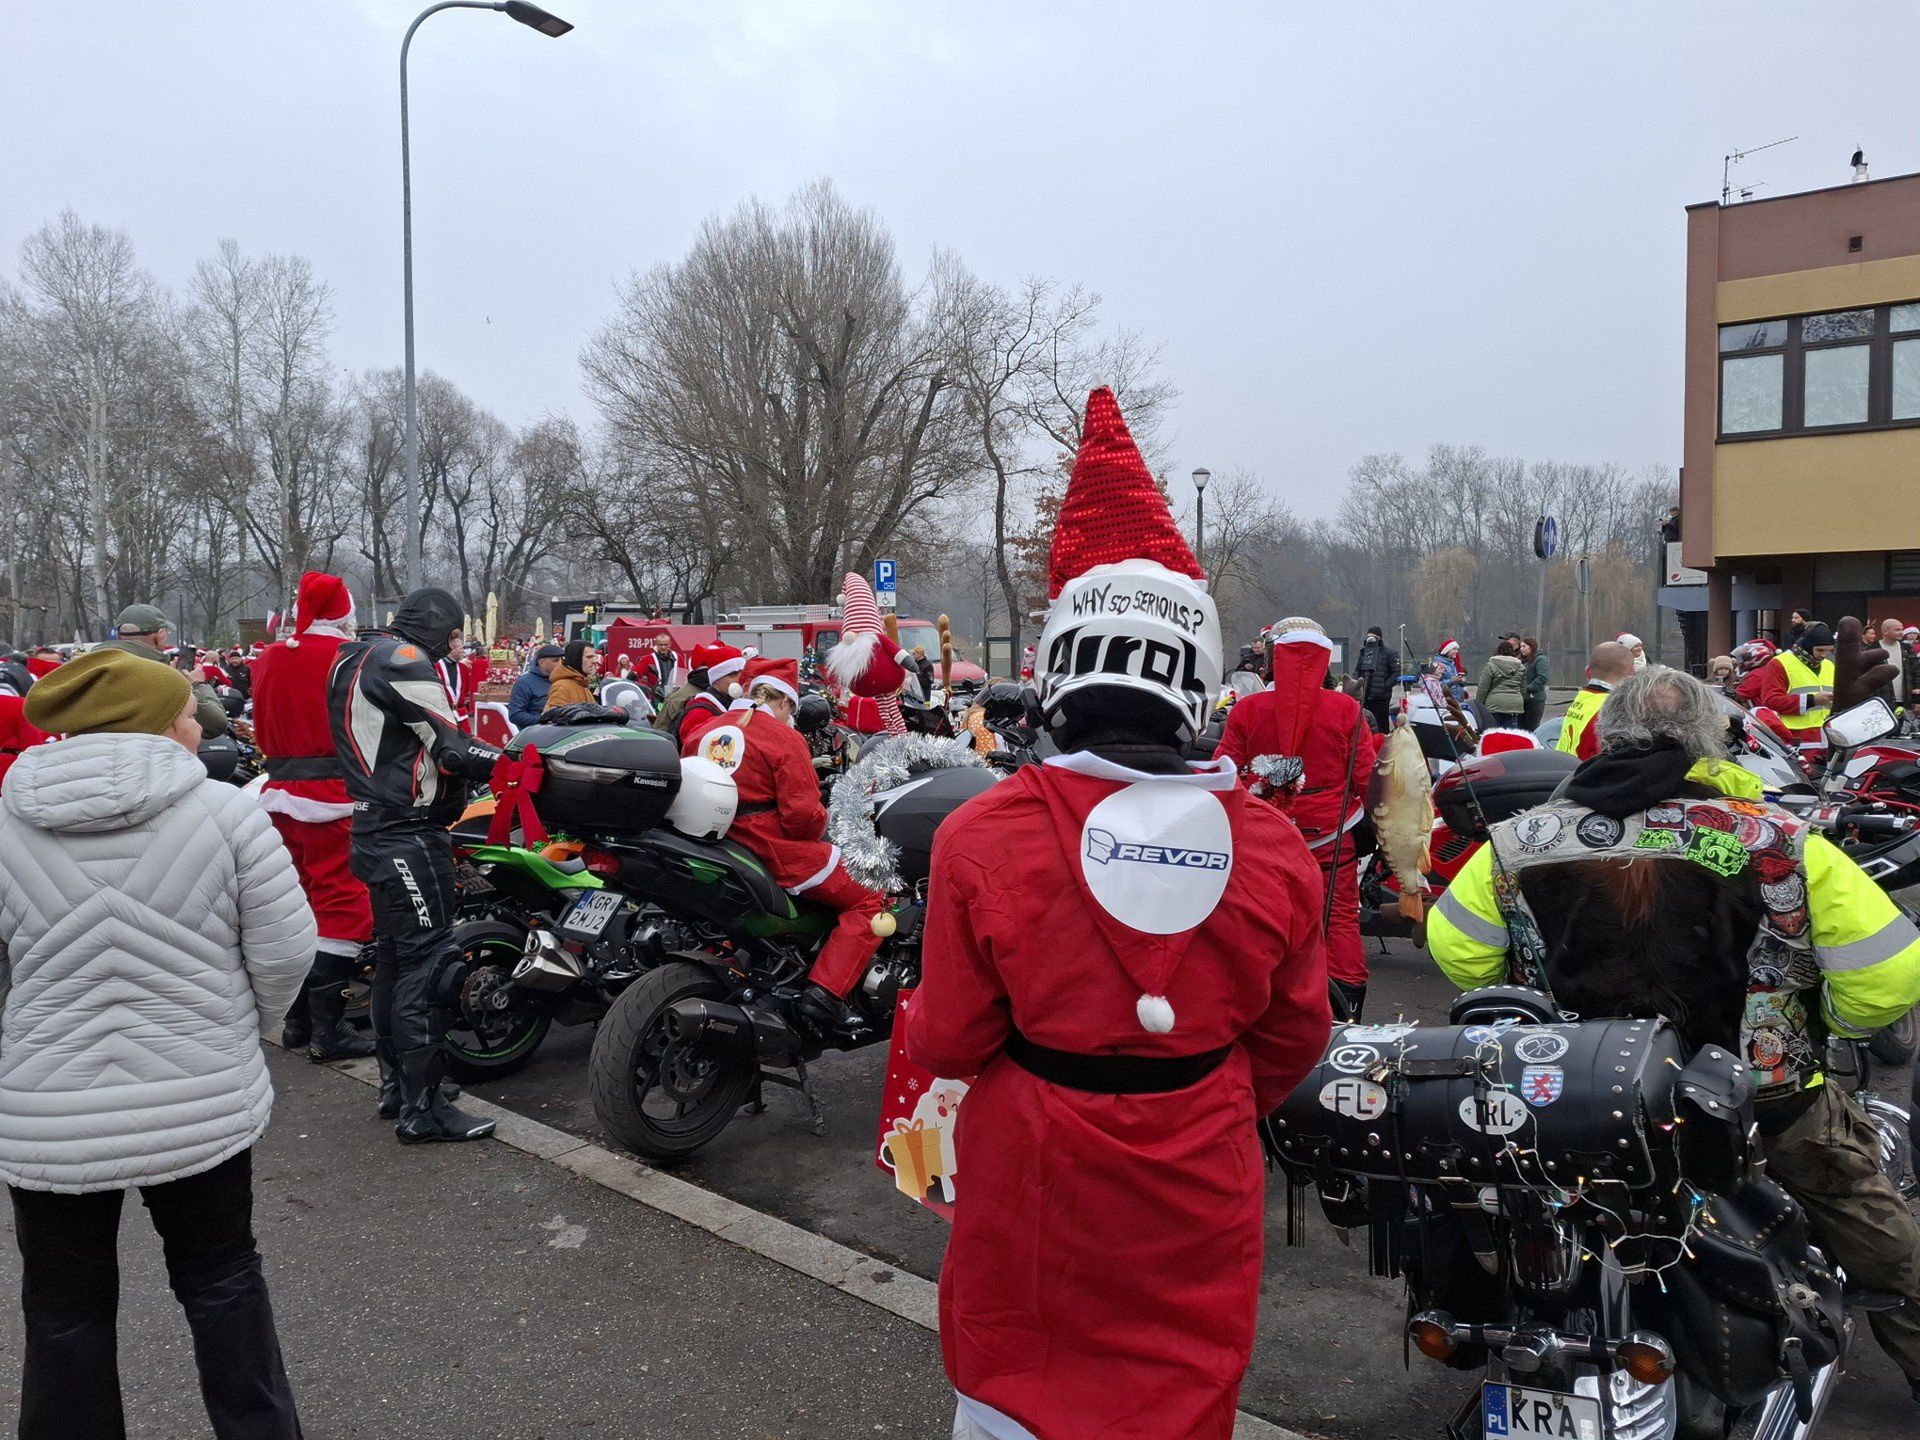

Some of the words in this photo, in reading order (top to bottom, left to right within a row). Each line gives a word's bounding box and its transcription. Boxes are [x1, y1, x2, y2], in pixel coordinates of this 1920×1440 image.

[880, 562, 892, 583] P
[1072, 582, 1112, 618] WHY
[1108, 595, 1131, 616] SO
[1132, 589, 1205, 636] SERIOUS?
[467, 745, 500, 761] DAINE
[633, 776, 668, 788] Kawasaki
[1117, 844, 1228, 869] REVOR
[392, 858, 433, 928] DAINESE
[586, 895, 612, 911] KGR
[568, 911, 605, 930] 2MJ2
[1336, 1049, 1371, 1067] CZ
[1335, 1083, 1373, 1115] FL
[1487, 1413, 1507, 1431] PL
[1511, 1398, 1579, 1440] KRA
